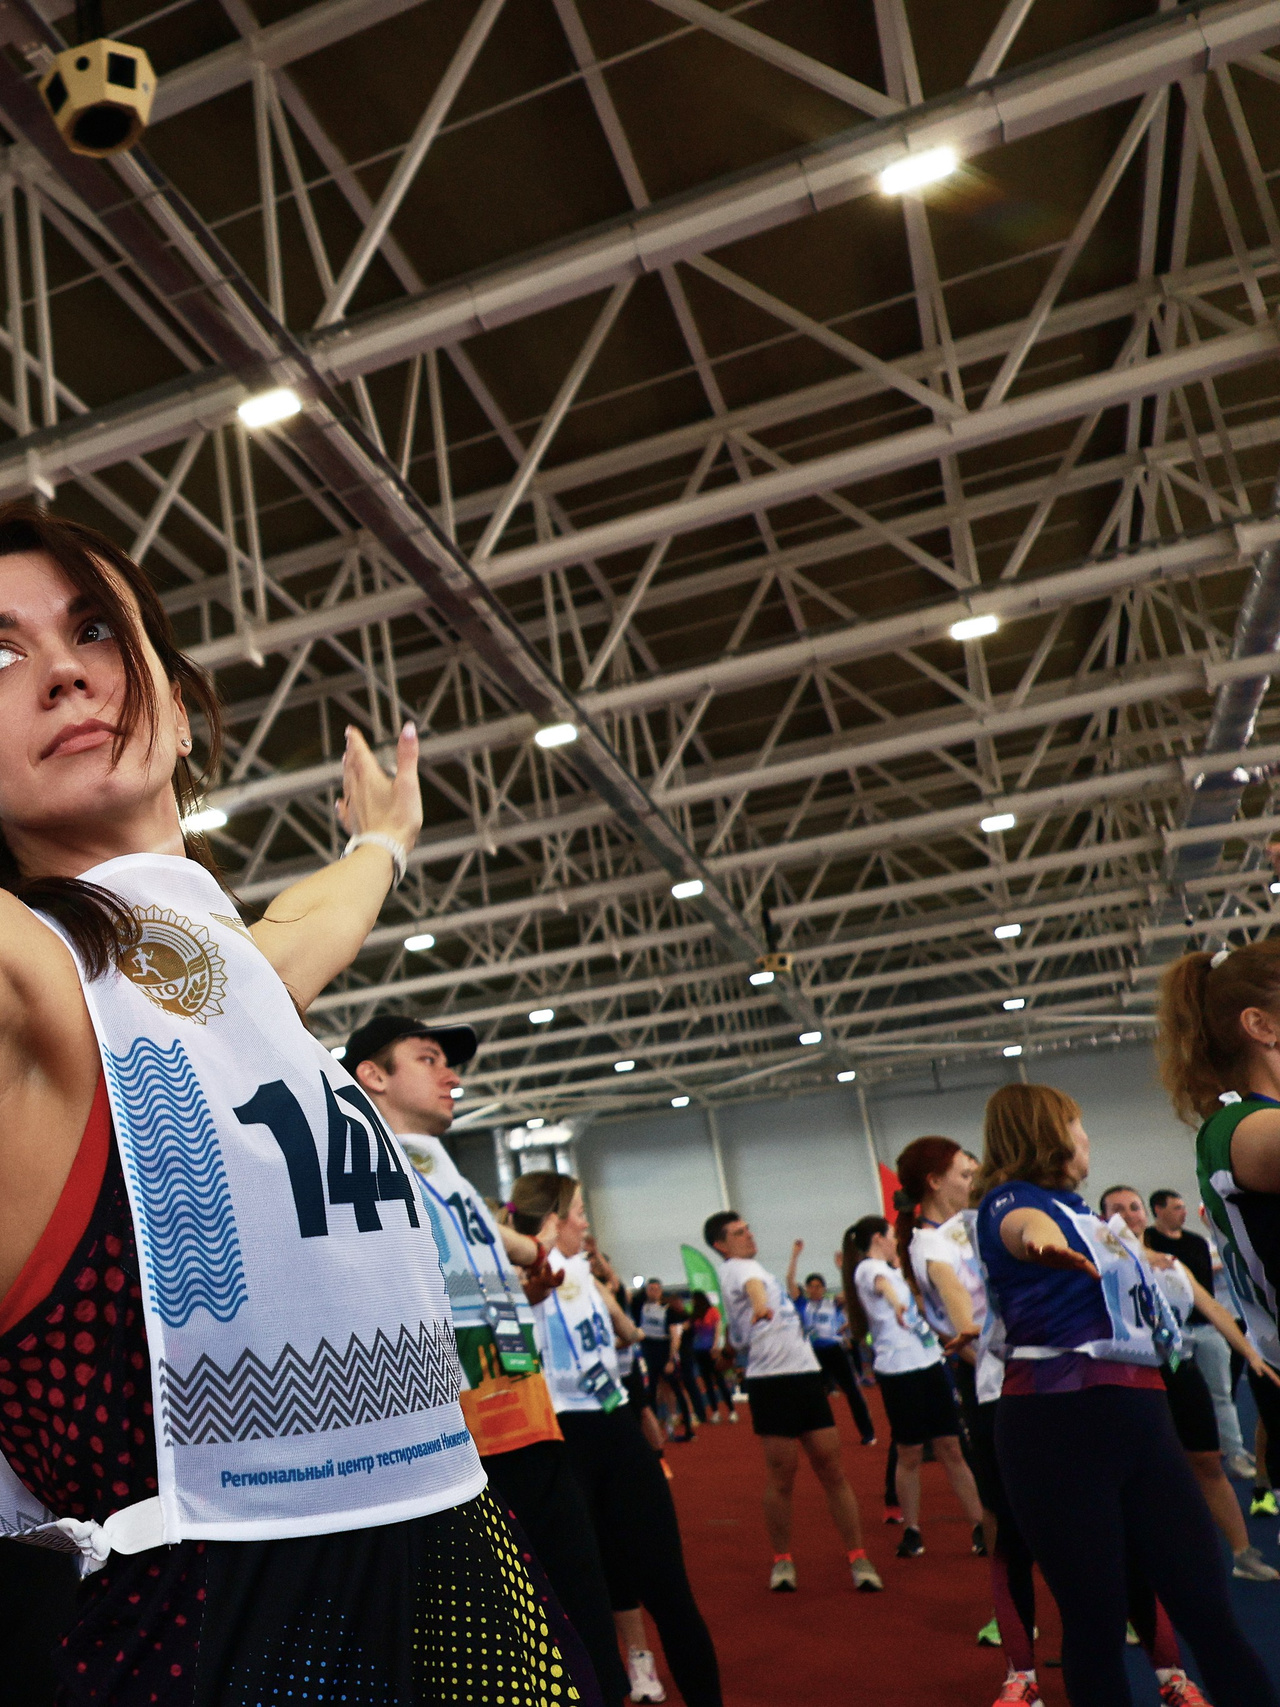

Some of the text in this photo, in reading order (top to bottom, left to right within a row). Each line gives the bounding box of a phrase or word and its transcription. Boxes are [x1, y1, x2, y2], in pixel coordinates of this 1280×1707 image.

[232, 1069, 420, 1238] 144
[221, 1459, 335, 1488] Региональный
[337, 1455, 374, 1477] центр
[376, 1438, 442, 1468] тестирования
